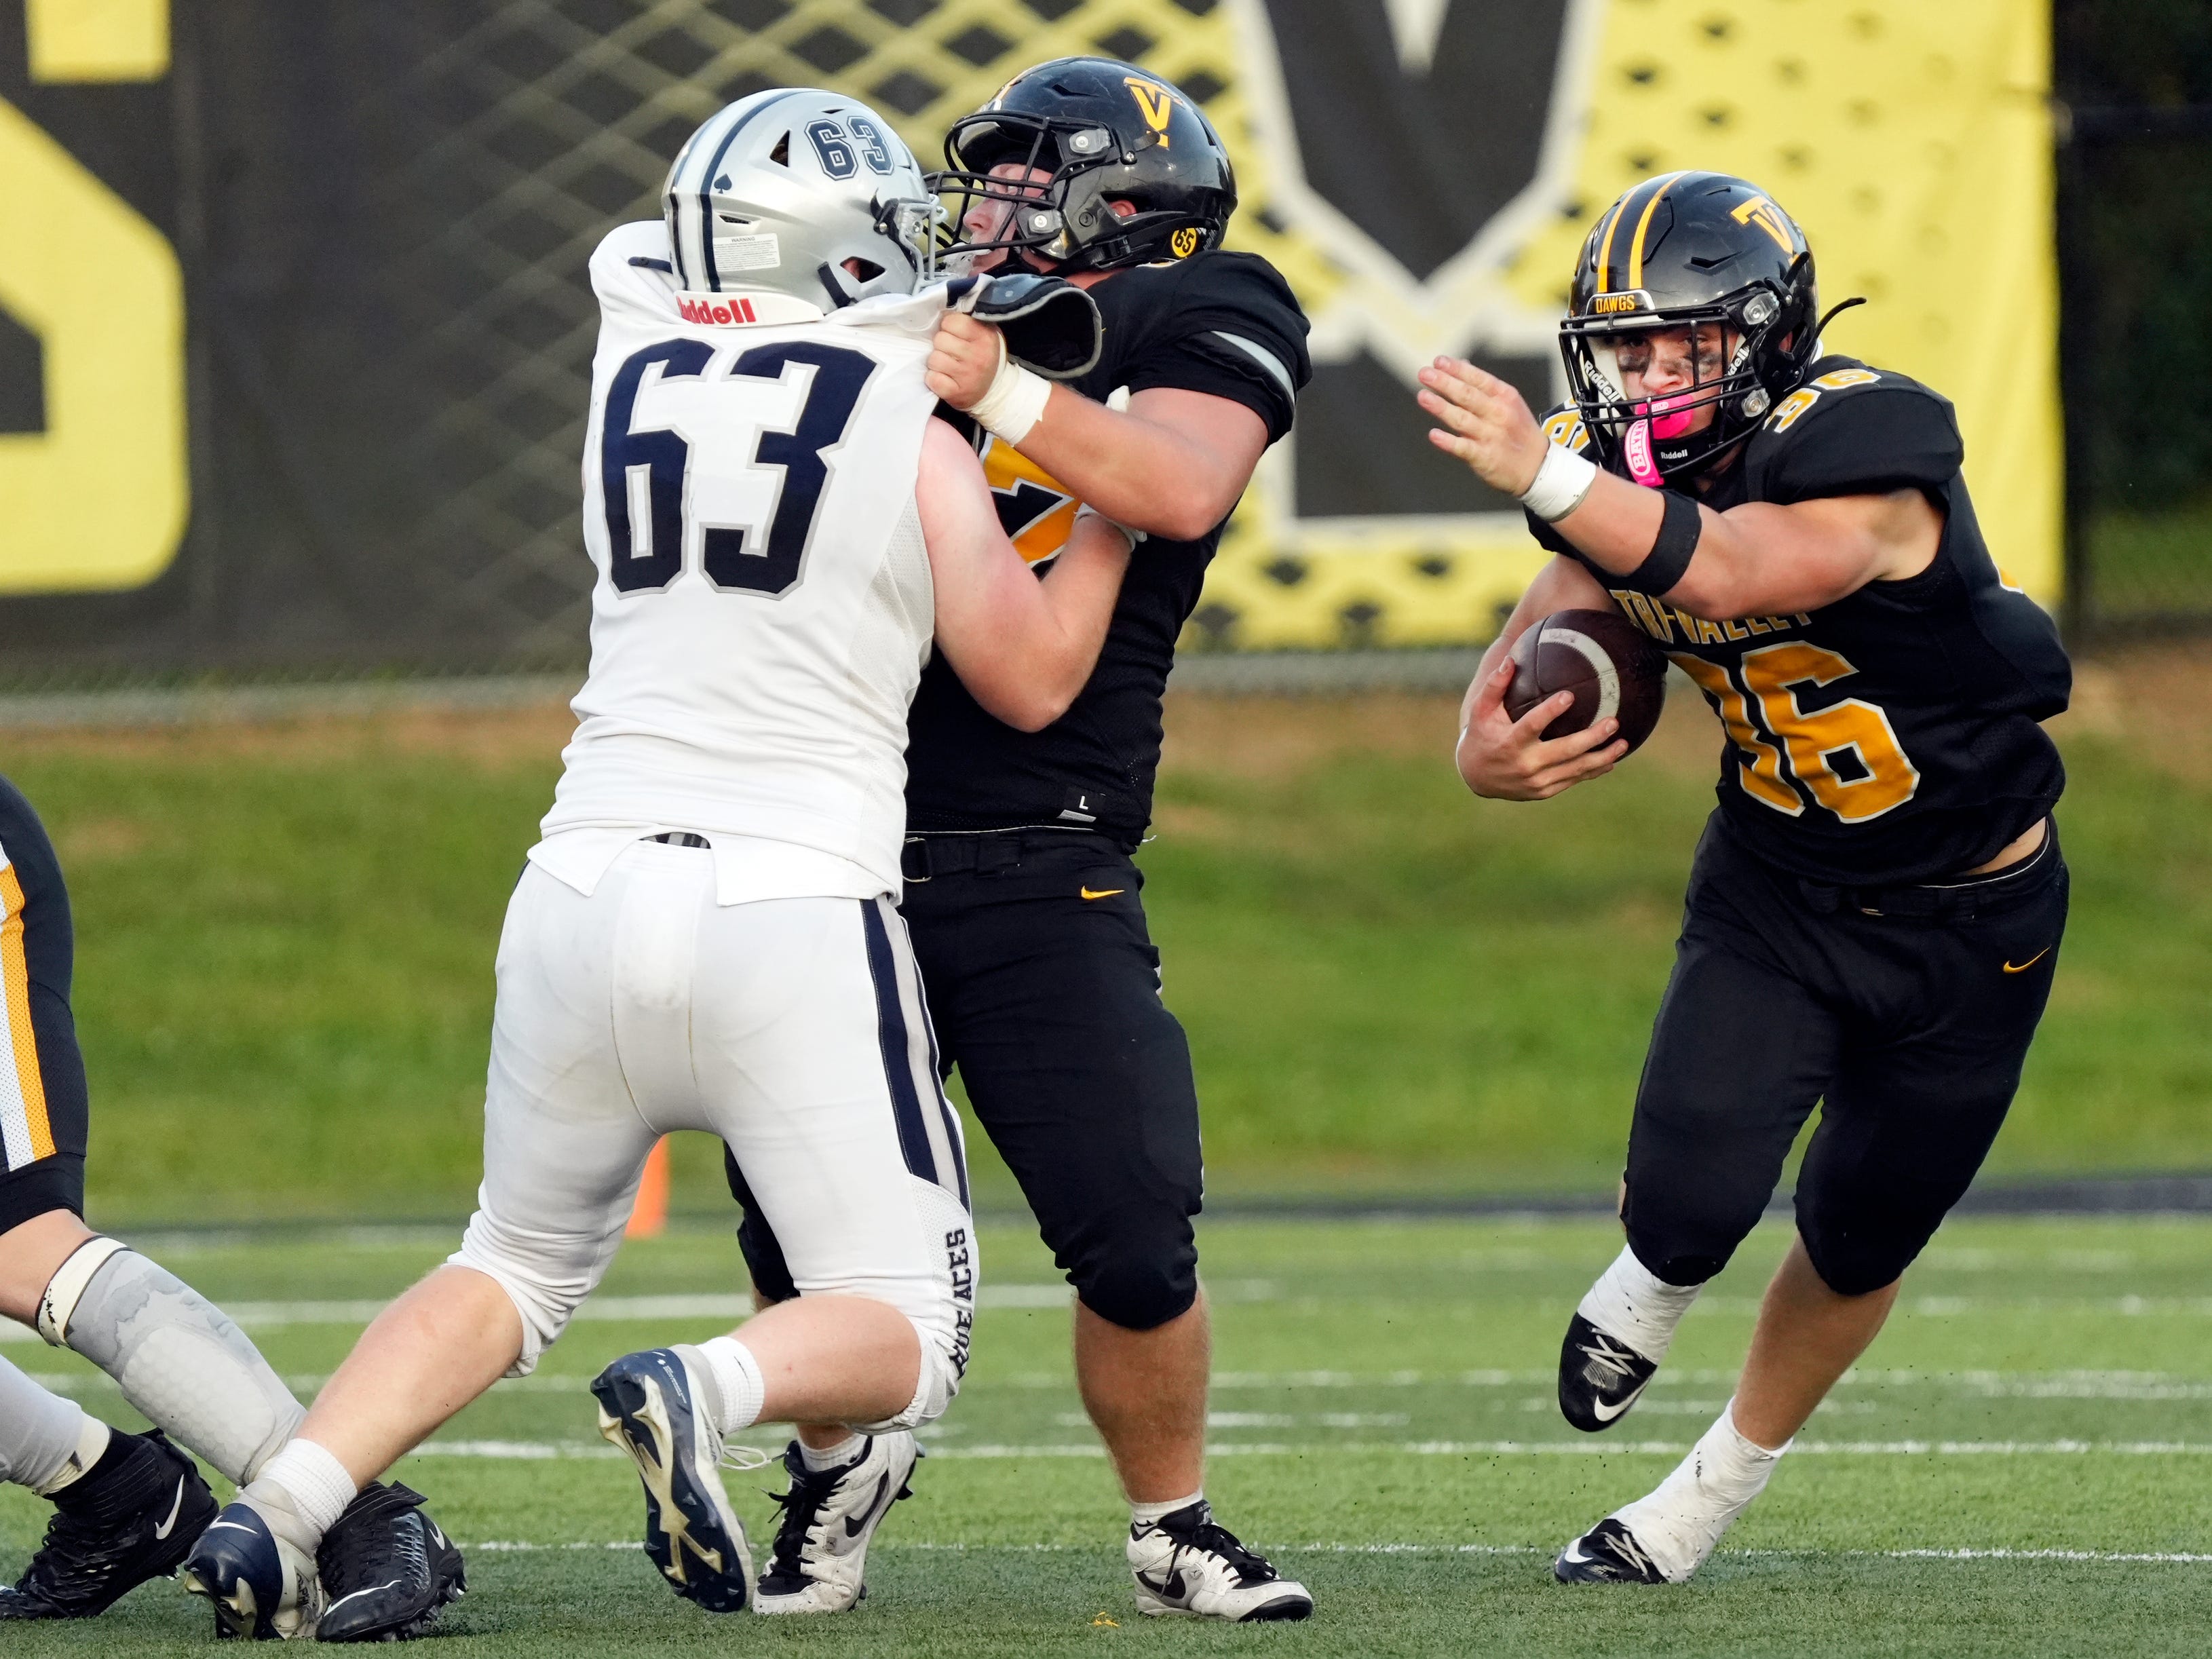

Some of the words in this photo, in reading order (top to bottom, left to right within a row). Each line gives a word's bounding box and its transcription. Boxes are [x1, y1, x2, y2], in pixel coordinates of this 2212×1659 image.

[805, 115, 894, 181] 63
[1175, 227, 1194, 253] 65
[1595, 294, 1635, 314] DAWGS
[1584, 360, 1621, 403] Riddell
[601, 337, 885, 602] 63
[1660, 449, 1689, 459] Riddell
[1079, 795, 1088, 810] L
[946, 1227, 972, 1301] ACES
